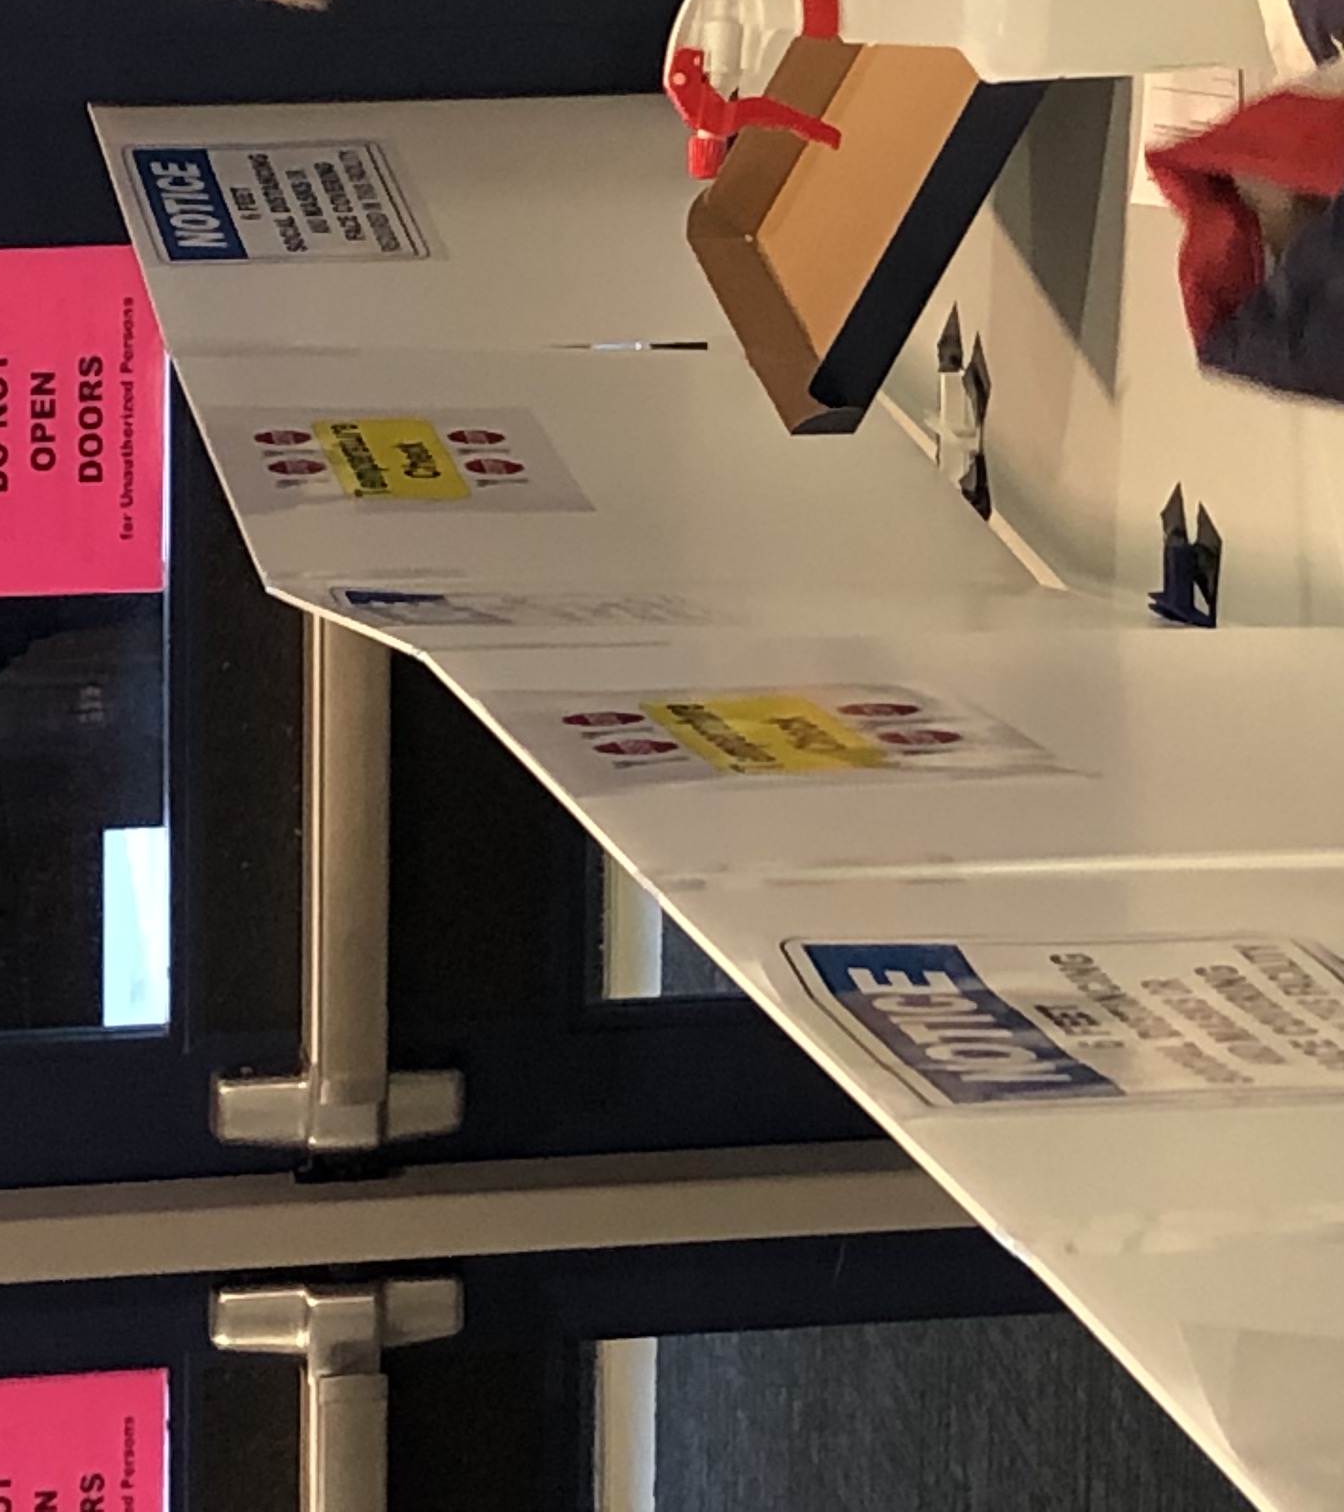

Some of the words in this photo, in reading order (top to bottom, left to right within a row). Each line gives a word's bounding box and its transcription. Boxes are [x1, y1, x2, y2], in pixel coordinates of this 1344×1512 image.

[149, 161, 229, 248] NOTICE
[230, 187, 258, 212] FEET
[247, 153, 291, 213] DISTANCING
[291, 182, 324, 217] MASKS
[313, 162, 354, 213] COVERING
[274, 216, 307, 252] SOCIAL
[336, 215, 366, 241] FACE
[120, 297, 134, 374] Persons
[30, 372, 56, 472] OPEN
[78, 356, 103, 483] DOORS
[119, 381, 134, 508] Unauthorized
[330, 424, 392, 498] Temperature
[390, 441, 441, 479] Check
[119, 514, 134, 540] for
[1233, 944, 1330, 997] FACILITY
[846, 967, 1073, 1082] NOTICE
[1034, 1005, 1112, 1037] FEET
[120, 1416, 136, 1490] Persons
